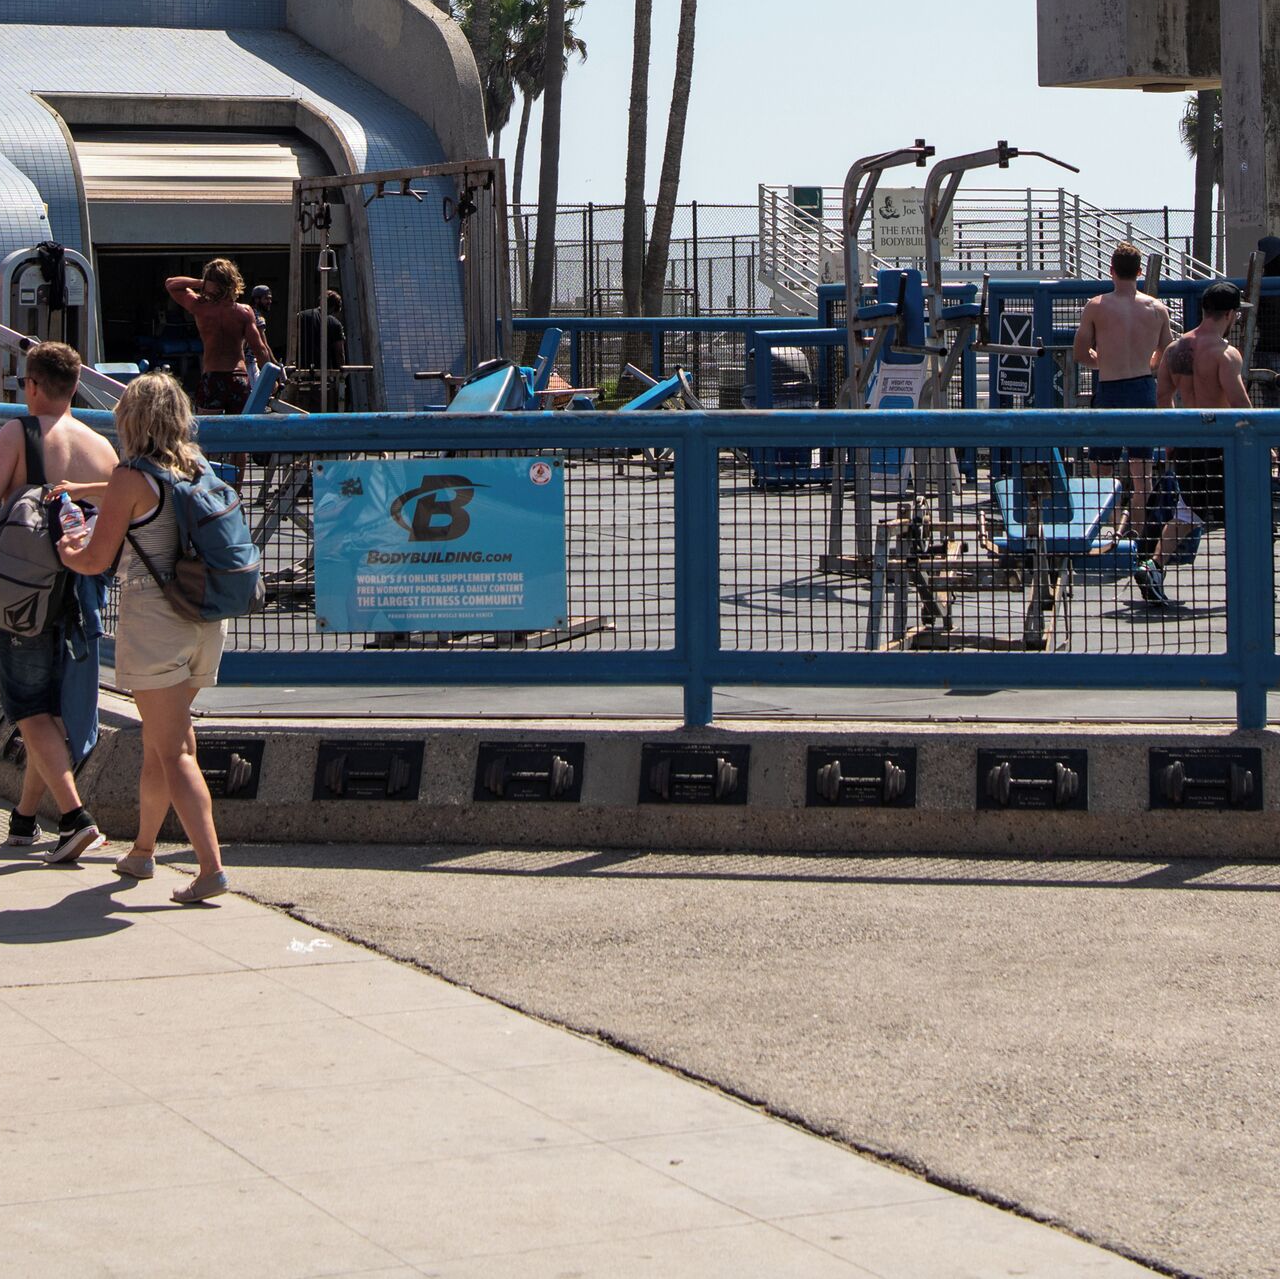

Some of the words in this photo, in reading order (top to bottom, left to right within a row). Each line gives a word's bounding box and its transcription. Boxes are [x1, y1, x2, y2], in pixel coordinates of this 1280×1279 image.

[903, 205, 917, 216] Joe
[880, 226, 899, 235] THE
[901, 226, 926, 235] FATH
[880, 237, 949, 247] BODYBUILG
[356, 574, 395, 584] WORLD'S
[408, 573, 439, 584] ONLINE
[441, 573, 495, 583] SUPPLEMENT
[497, 572, 524, 582] STORE
[357, 586, 375, 595] FREE
[377, 586, 414, 594] WORKOUT
[416, 585, 458, 593] PROGRAMS
[466, 585, 488, 593] DAILY
[489, 584, 524, 593] CONTENT
[357, 597, 375, 607] THE
[377, 596, 419, 607] LARGEST
[421, 596, 460, 606] FITNESS
[462, 595, 524, 606] COMMUNITY
